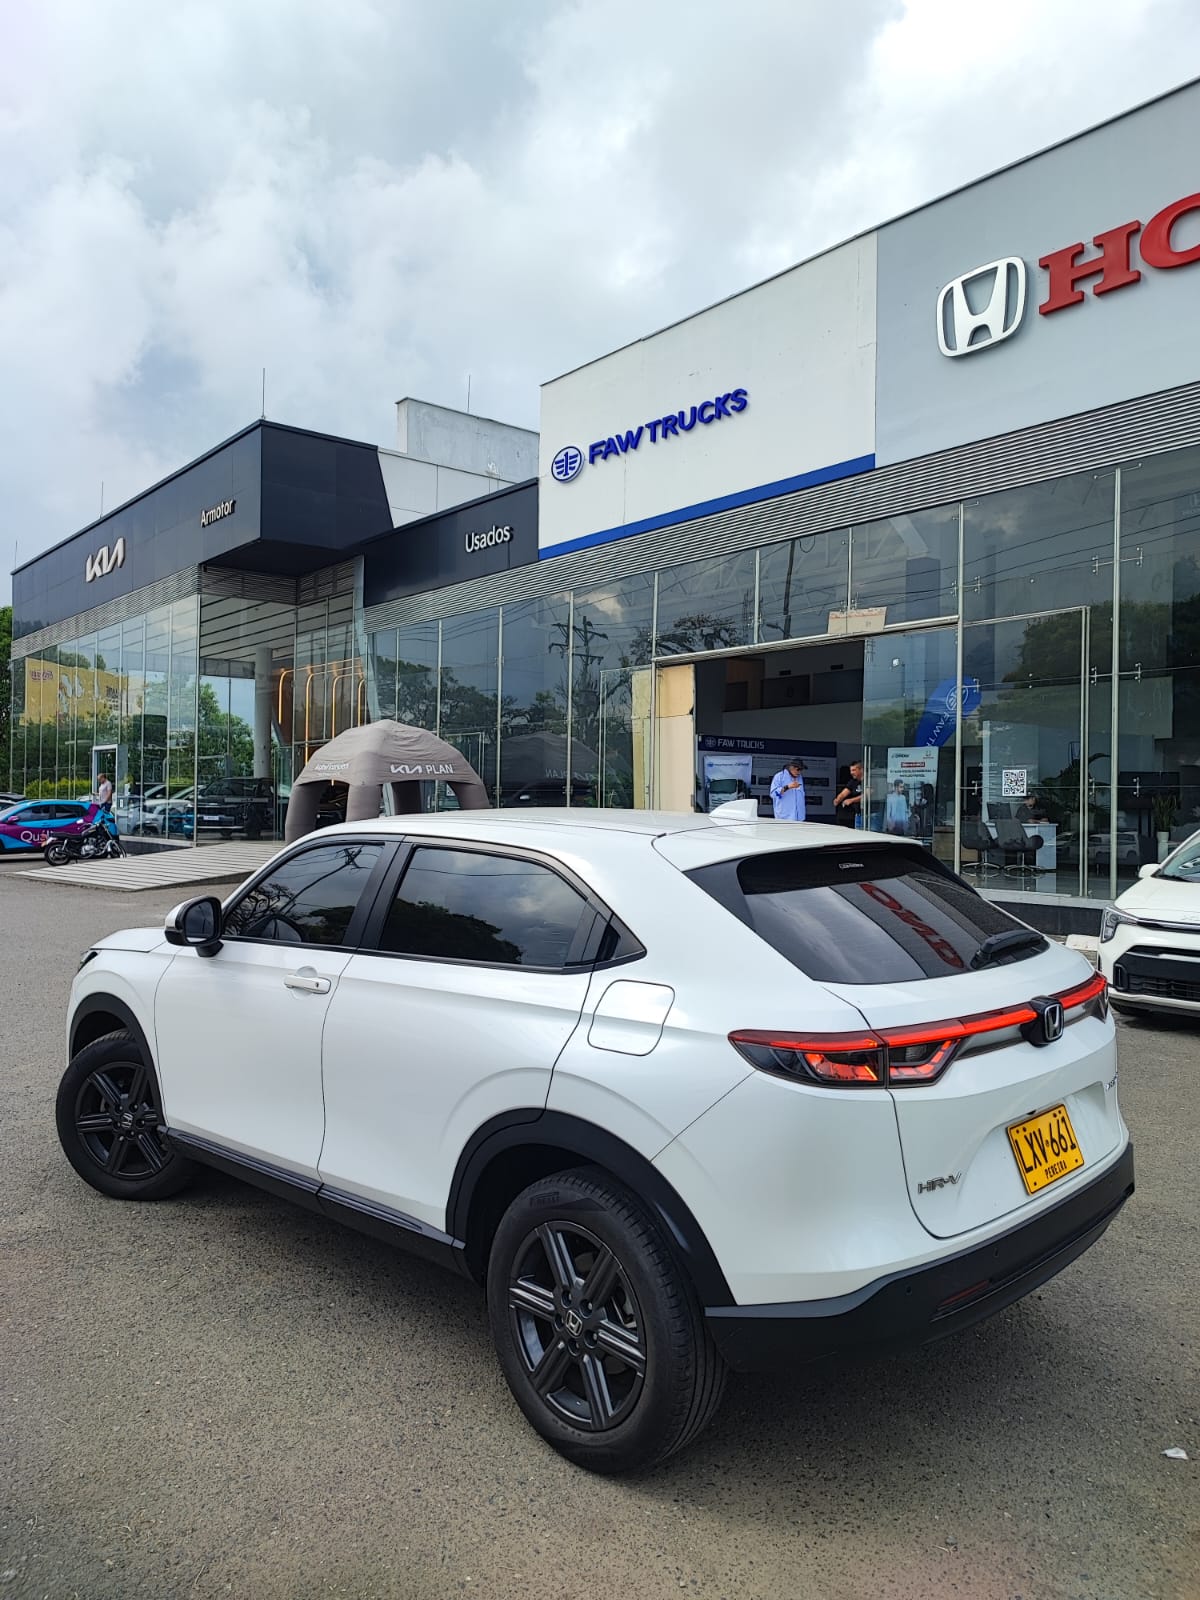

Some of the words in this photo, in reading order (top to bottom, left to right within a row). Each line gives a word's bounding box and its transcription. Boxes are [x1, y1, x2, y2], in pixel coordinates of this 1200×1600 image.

[588, 425, 644, 464] FAW
[645, 388, 748, 443] TRUCKS
[201, 500, 235, 527] Armotor
[465, 525, 511, 553] Usados
[85, 537, 125, 583] KIA
[717, 738, 735, 748] FAW
[735, 739, 765, 750] TRUCKS
[426, 764, 454, 774] PLAN
[1044, 1159, 1068, 1180] PEREIRA
[917, 1171, 962, 1195] HR-V
